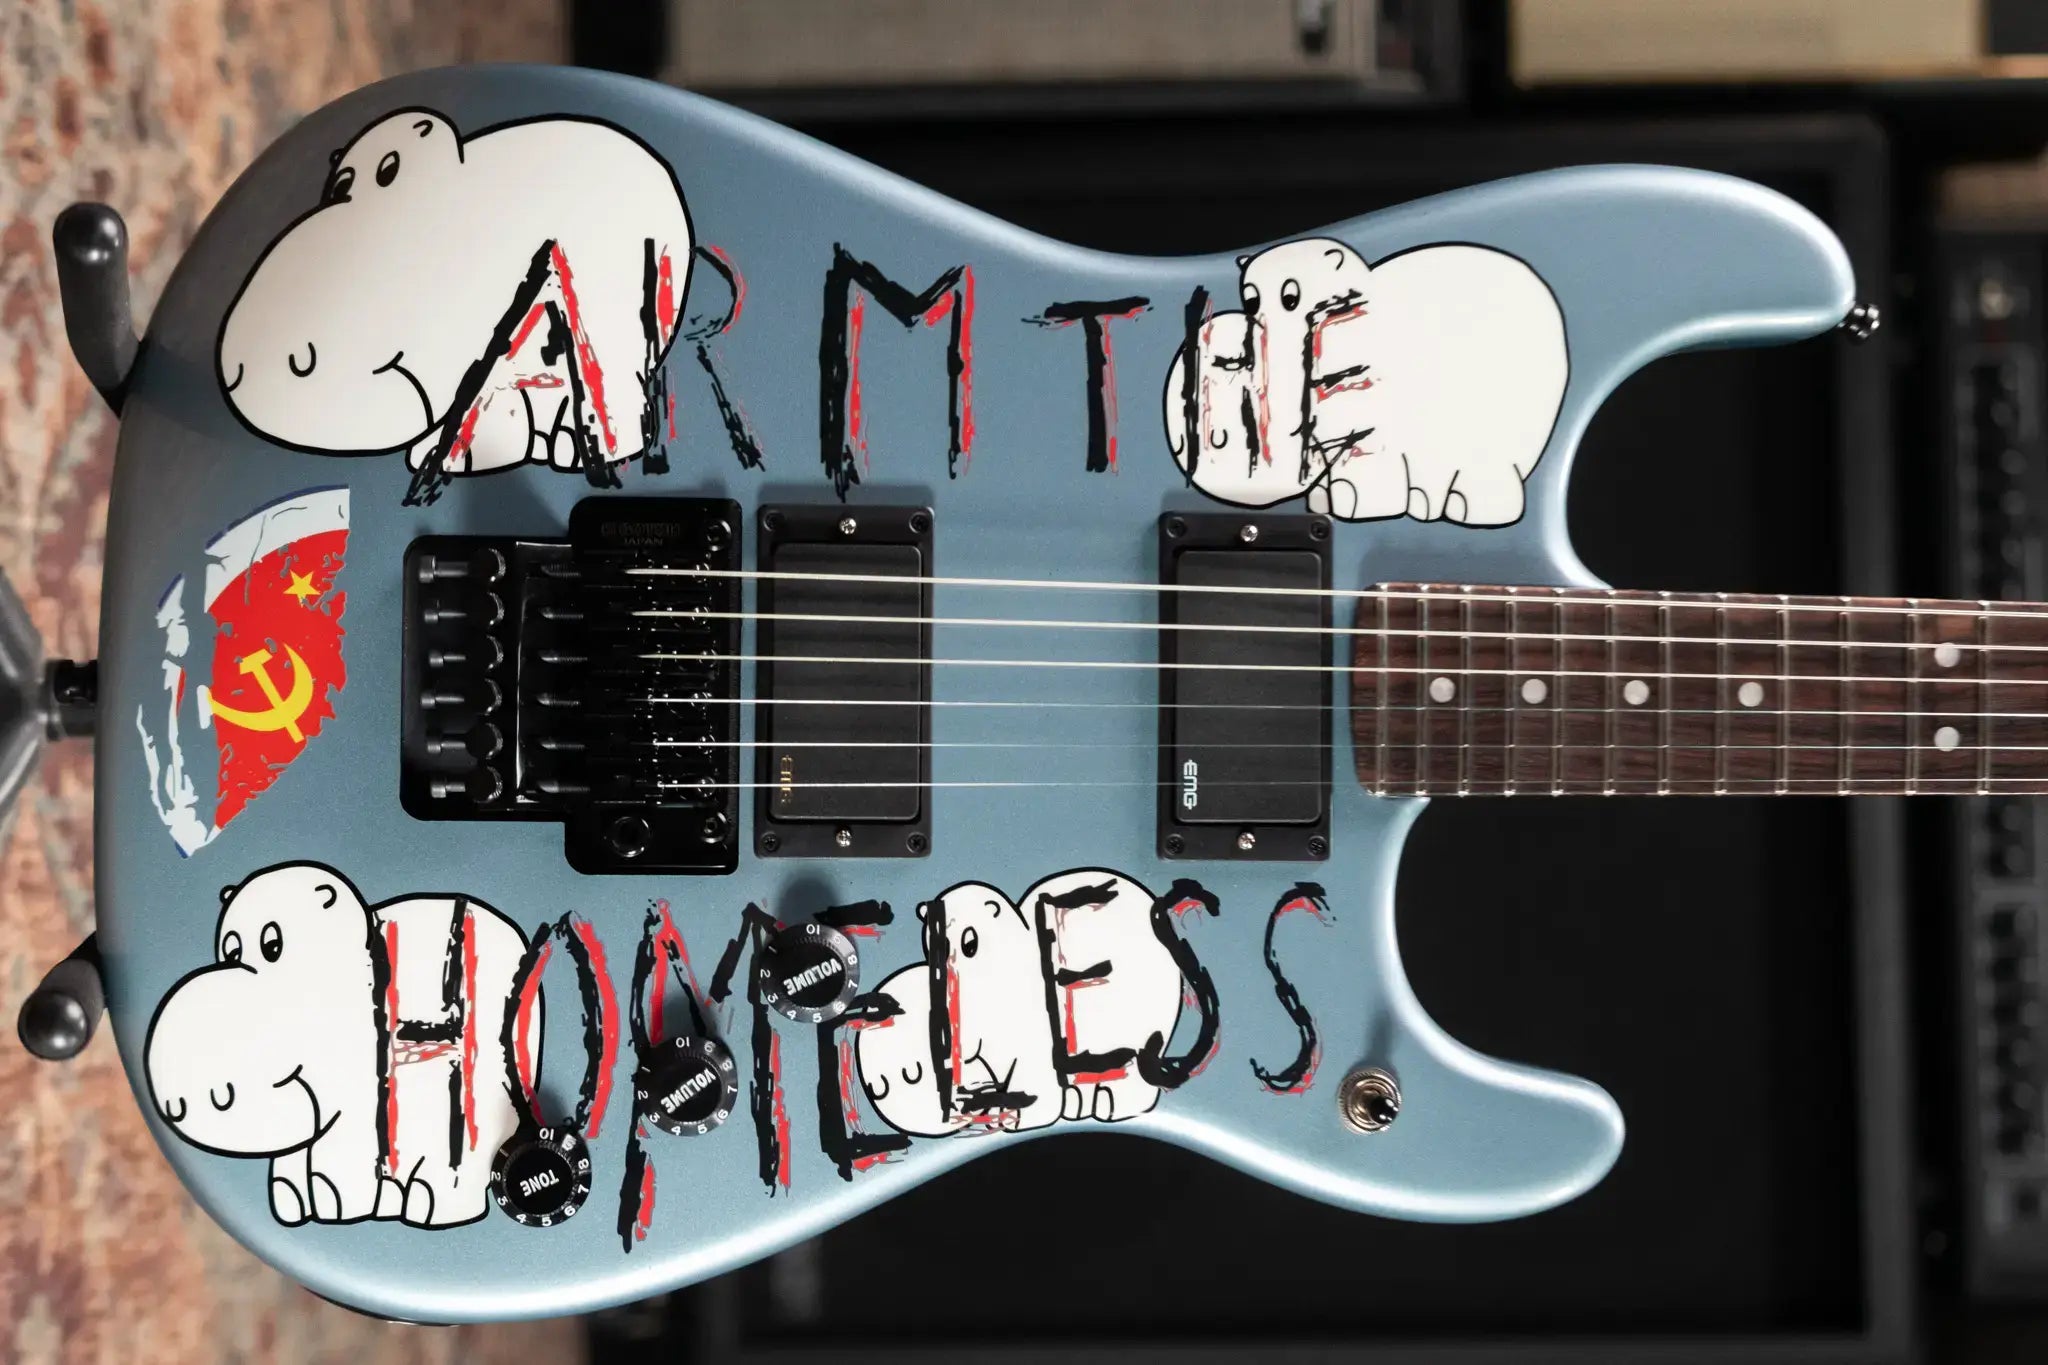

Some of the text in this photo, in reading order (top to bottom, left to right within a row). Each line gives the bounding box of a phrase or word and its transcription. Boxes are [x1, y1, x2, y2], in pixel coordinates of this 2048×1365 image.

[401, 238, 1376, 505] ARM THE
[1183, 759, 1198, 810] EMG
[806, 924, 820, 935] 10
[847, 954, 858, 966] 8
[760, 968, 771, 978] 2
[783, 958, 842, 996] VOLUME
[847, 979, 858, 989] 7
[767, 992, 779, 1004] 3
[787, 1009, 797, 1020] 4
[812, 1012, 823, 1023] 5
[676, 1036, 690, 1048] 10
[370, 878, 1336, 1253] HOMELESS
[722, 1057, 733, 1071] 8
[637, 1090, 649, 1100] 2
[660, 1067, 716, 1114] VOLUME
[727, 1085, 738, 1094] 7
[649, 1112, 661, 1123] 3
[717, 1109, 729, 1120] 6
[539, 1128, 555, 1140] 10
[671, 1125, 681, 1136] 4
[697, 1123, 708, 1134] 5
[578, 1158, 589, 1170] 8
[491, 1171, 501, 1181] 2
[519, 1169, 560, 1197] TONE
[577, 1184, 589, 1194] 7
[497, 1195, 509, 1206] 3
[564, 1205, 576, 1216] 6
[516, 1213, 527, 1223] 4
[541, 1216, 552, 1227] 5
